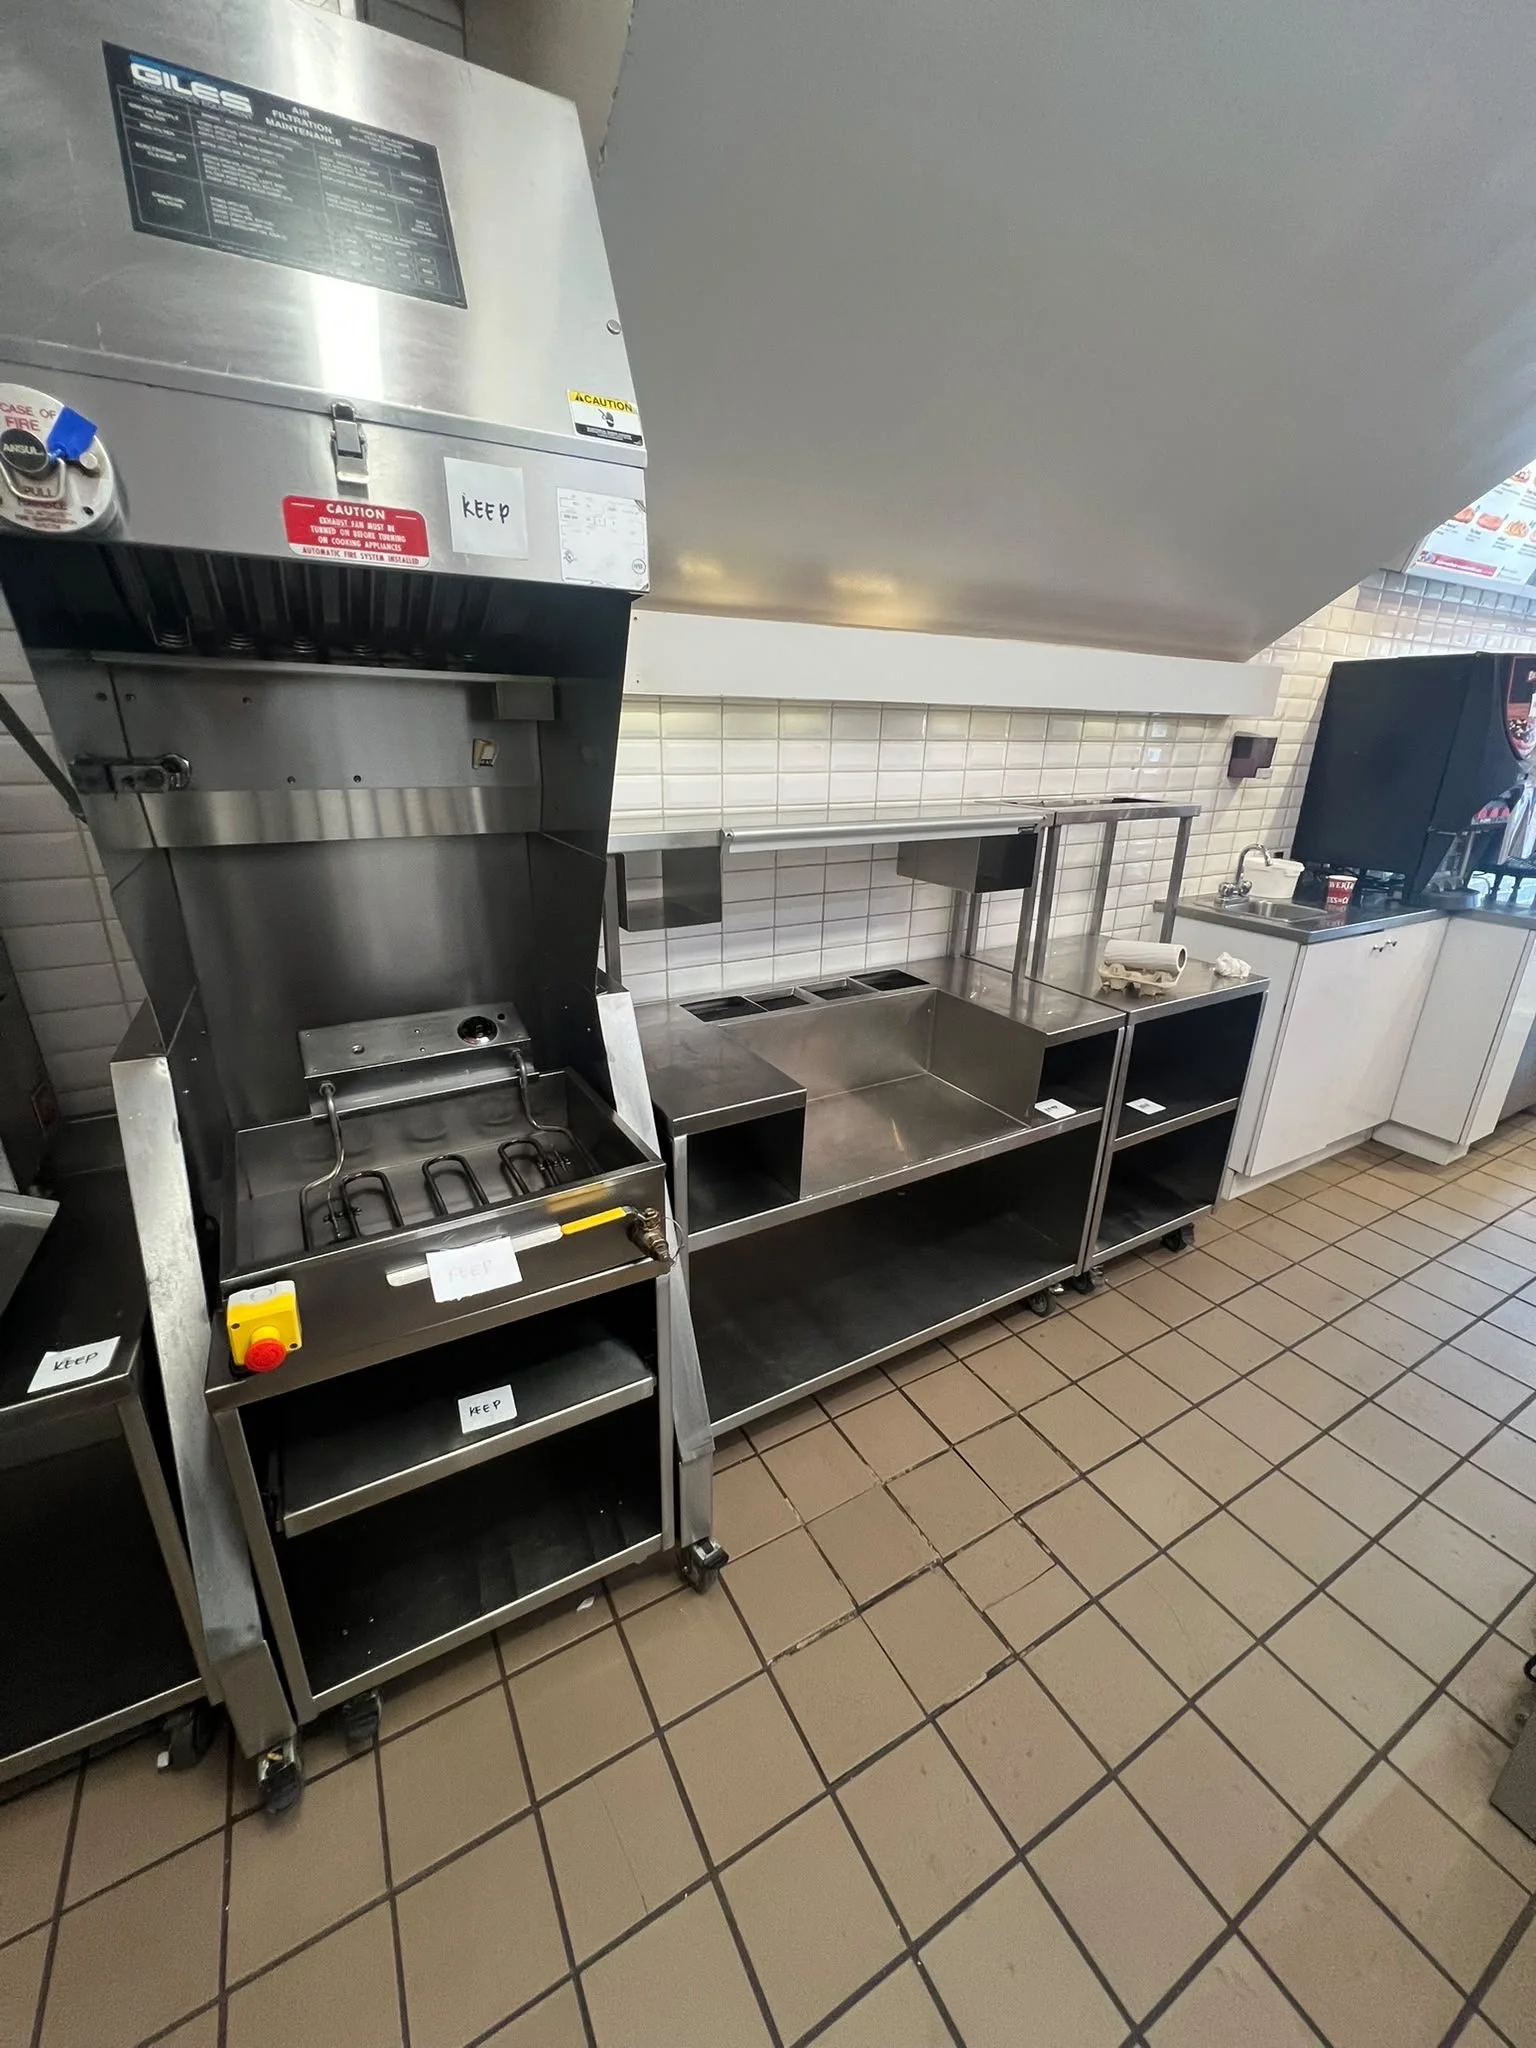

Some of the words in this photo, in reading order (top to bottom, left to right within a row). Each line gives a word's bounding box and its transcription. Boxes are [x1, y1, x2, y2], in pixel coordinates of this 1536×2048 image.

[130, 62, 252, 113] GILES
[292, 105, 310, 119] AIR
[272, 109, 333, 134] FILTRATION
[265, 117, 343, 147] MAINTENANCE
[0, 402, 33, 417] CASE
[39, 408, 56, 420] OF
[584, 394, 633, 413] CAUTION
[5, 415, 41, 432] FIRE
[3, 443, 44, 456] ANSUL
[326, 503, 385, 520] CAUTION
[462, 493, 510, 524] KEEP
[319, 516, 347, 528] EXHAUST
[367, 522, 384, 531] MUST
[387, 524, 395, 533] BE
[310, 525, 337, 535] TURNED
[339, 529, 350, 537] ON
[353, 530, 376, 540] BEFORE
[378, 533, 407, 543] TURNING
[318, 536, 329, 544] ON
[331, 537, 361, 548] COOKING
[365, 541, 402, 552] APPLIANCES
[302, 546, 341, 557] AUTOMATIC
[343, 551, 357, 559] FIRE
[360, 552, 385, 561] SYSTEM
[388, 555, 420, 565] INSTALLED
[53, 1352, 98, 1371] KEEP
[469, 1399, 501, 1417] KEEP
